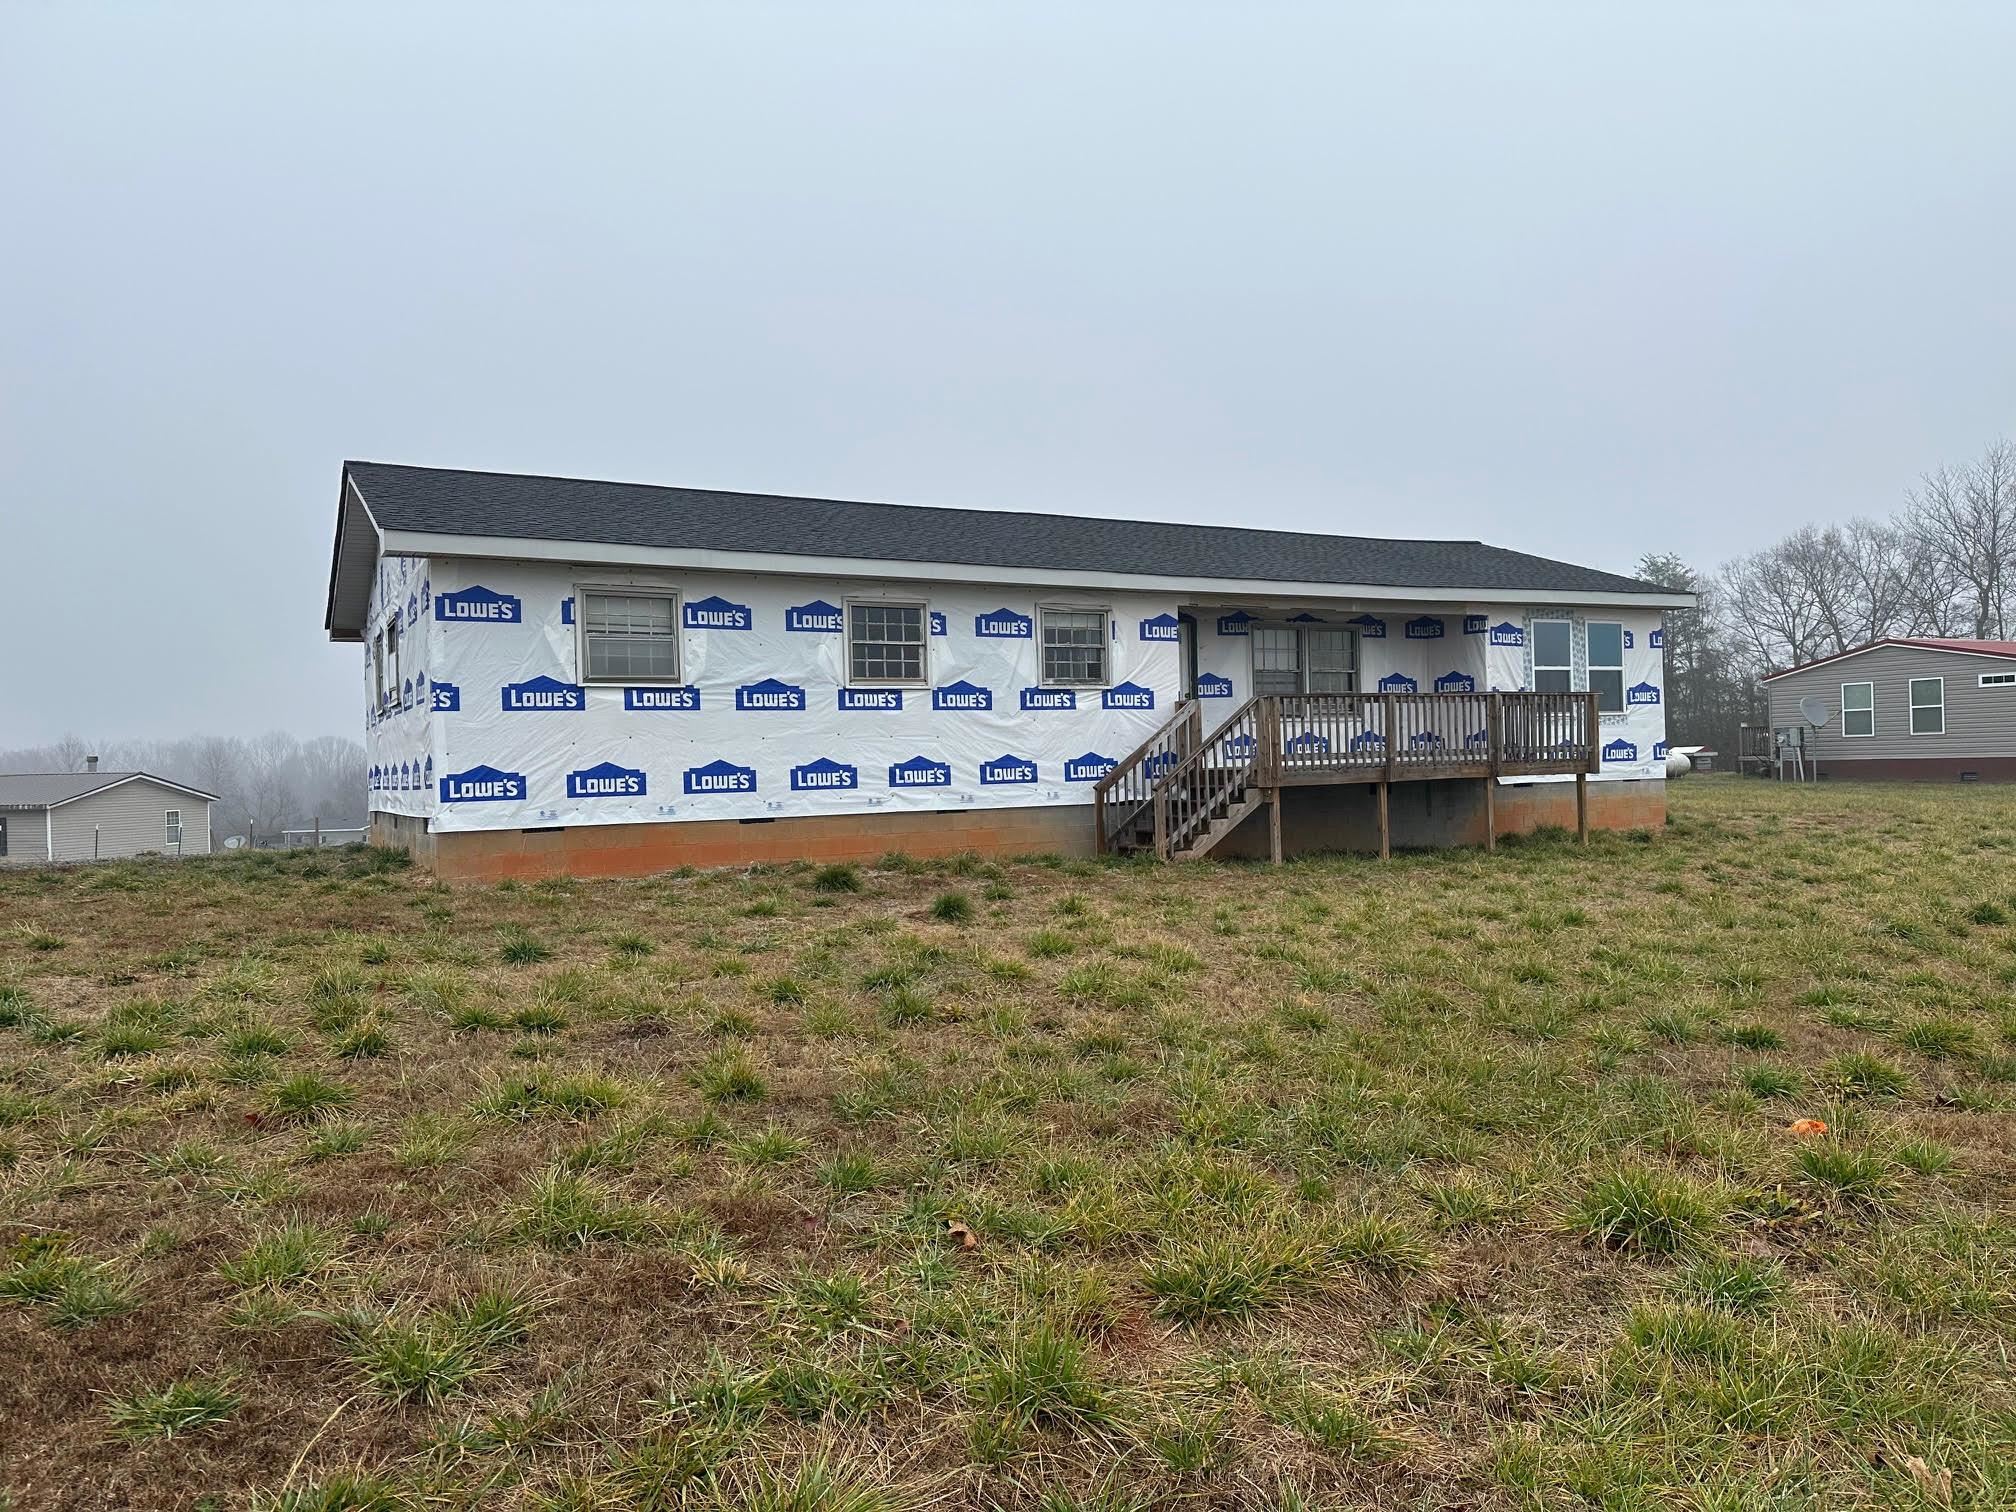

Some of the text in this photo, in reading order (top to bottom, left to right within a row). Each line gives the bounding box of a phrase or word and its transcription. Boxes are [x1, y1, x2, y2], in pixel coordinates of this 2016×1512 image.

[445, 600, 513, 619] LOWE'S
[687, 609, 745, 627] LOWE'S
[981, 619, 1028, 635] LOWE'S
[1362, 624, 1383, 636] WE'S
[1409, 623, 1441, 636] LOWE'S
[1491, 630, 1523, 644] LOWE'S
[1198, 682, 1229, 695] OWE'S
[1381, 681, 1413, 693] LOWE'S
[1438, 680, 1471, 693] LOWE'S
[511, 689, 578, 707] LOWE'S
[632, 690, 693, 707] LOWE'S
[743, 690, 799, 707] LOWE'S
[844, 691, 897, 707] LOWE'S
[938, 691, 988, 707] LOWE'S
[1026, 692, 1072, 707] LOWE'S
[1107, 693, 1150, 707] LOWE'S
[1629, 690, 1657, 703] LOWE'S
[1605, 747, 1635, 759] LOWE'S
[691, 773, 750, 790] LOWE'S
[797, 770, 852, 787] LOWE'S
[895, 767, 945, 784] LOWE'S
[986, 766, 1032, 781] LOWE'S
[449, 778, 518, 799] LOWE'S
[575, 776, 640, 794] LOWE'S
